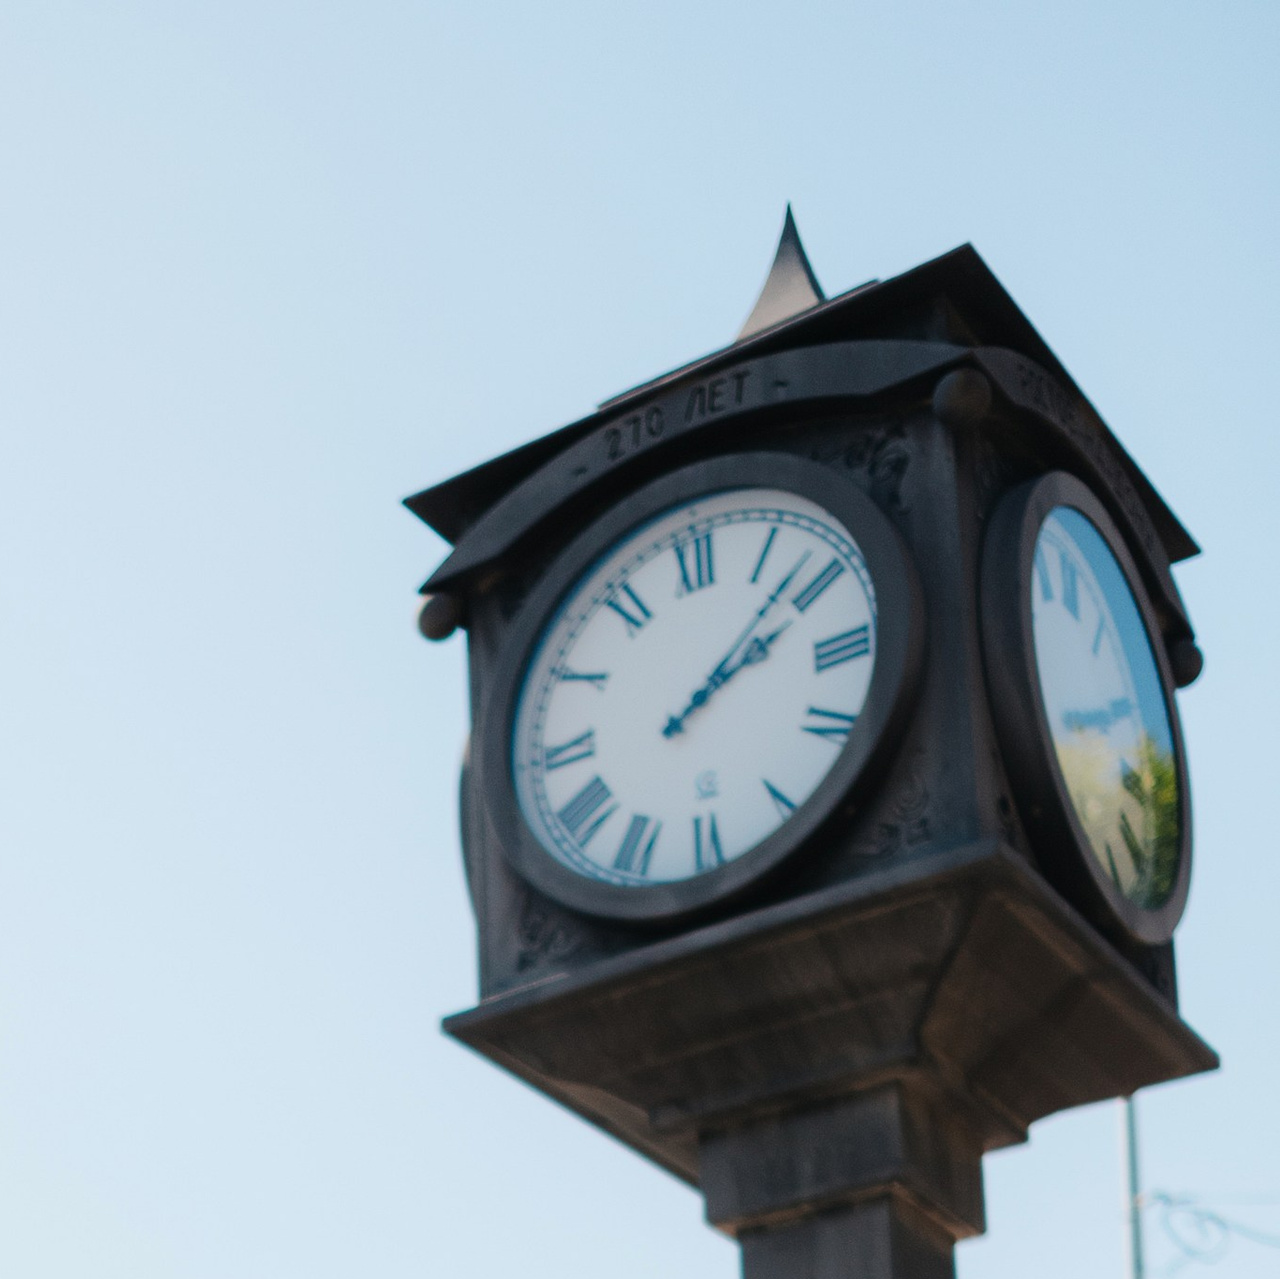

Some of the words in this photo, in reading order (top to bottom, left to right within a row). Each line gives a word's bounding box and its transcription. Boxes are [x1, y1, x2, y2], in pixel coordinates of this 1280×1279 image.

[604, 405, 665, 460] 270
[683, 369, 750, 423] ЛЕТ
[749, 526, 779, 584] I
[792, 557, 846, 613] II
[814, 623, 870, 674] III
